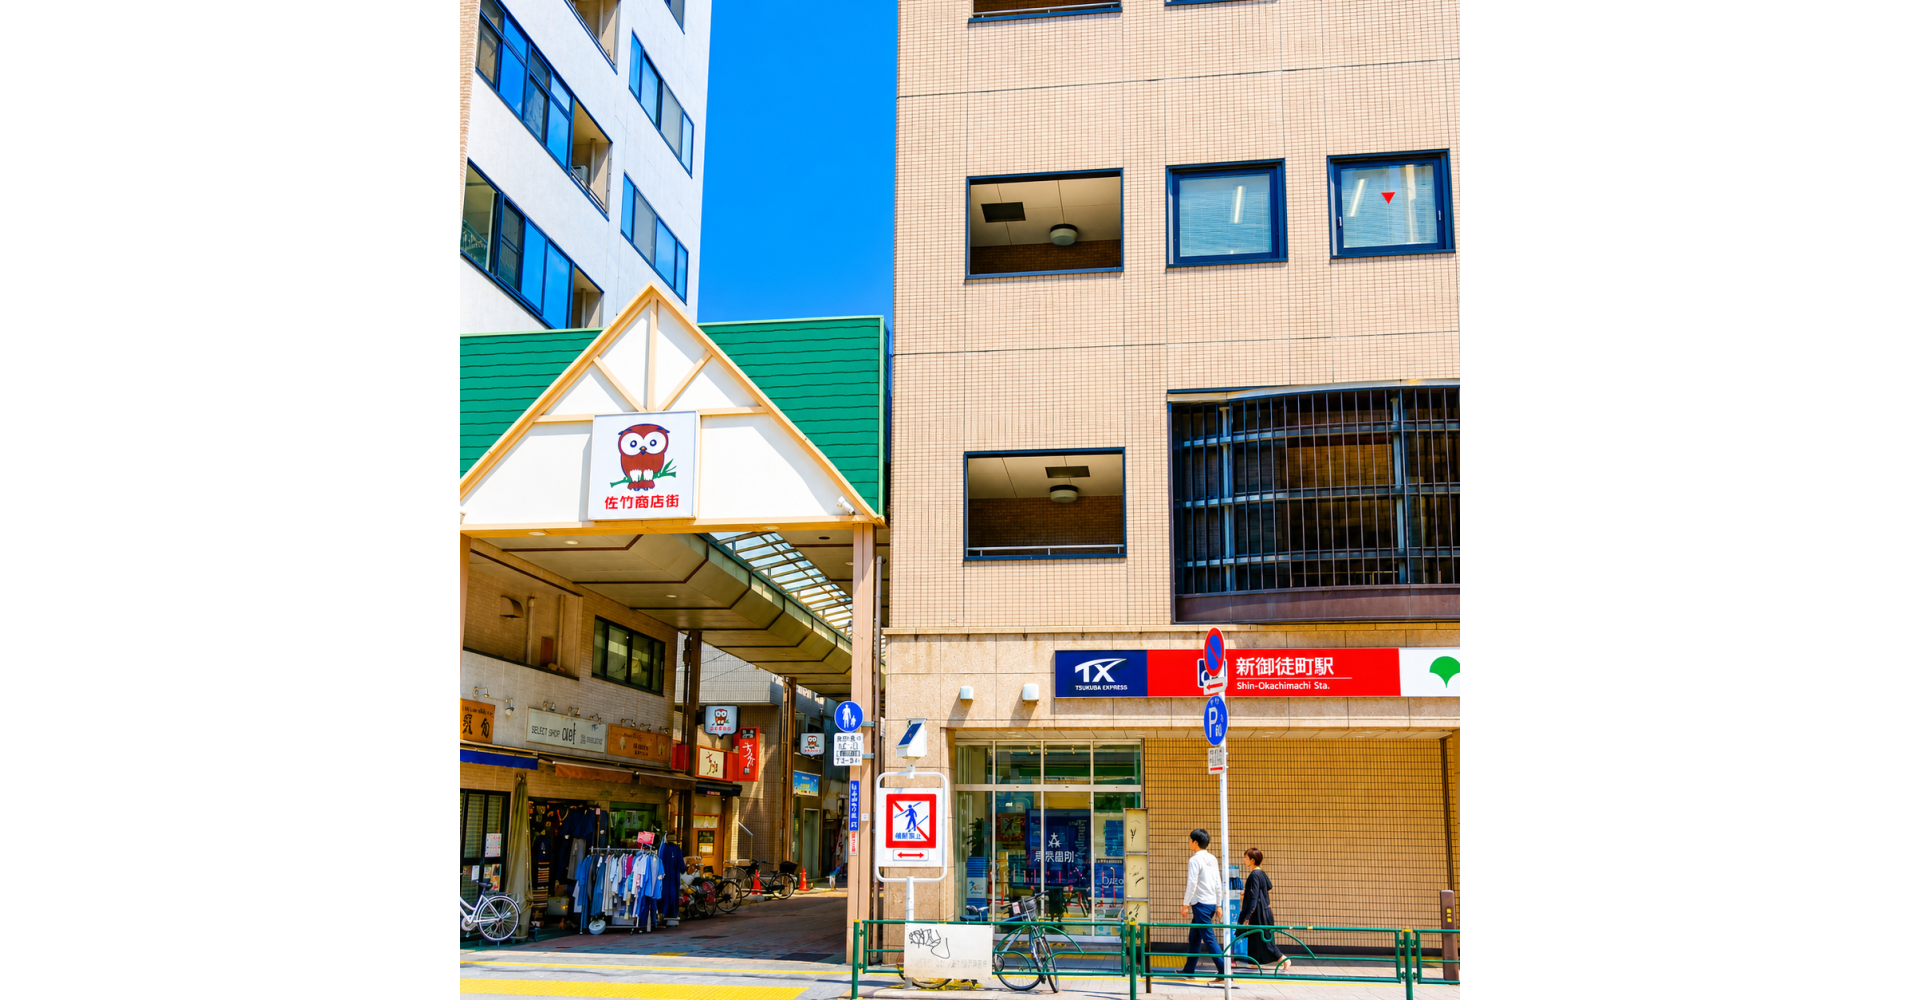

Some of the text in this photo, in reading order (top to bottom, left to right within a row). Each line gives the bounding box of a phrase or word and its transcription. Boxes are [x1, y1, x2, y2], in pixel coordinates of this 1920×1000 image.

[604, 494, 680, 510] 佐竹商店街
[1074, 658, 1127, 683] TX
[1236, 656, 1334, 676] 新御徒町駅
[1236, 681, 1331, 690] Shin-Okachimachi Sta.
[1208, 706, 1218, 738] P
[531, 725, 548, 736] SELECT
[548, 728, 560, 738] SHOP
